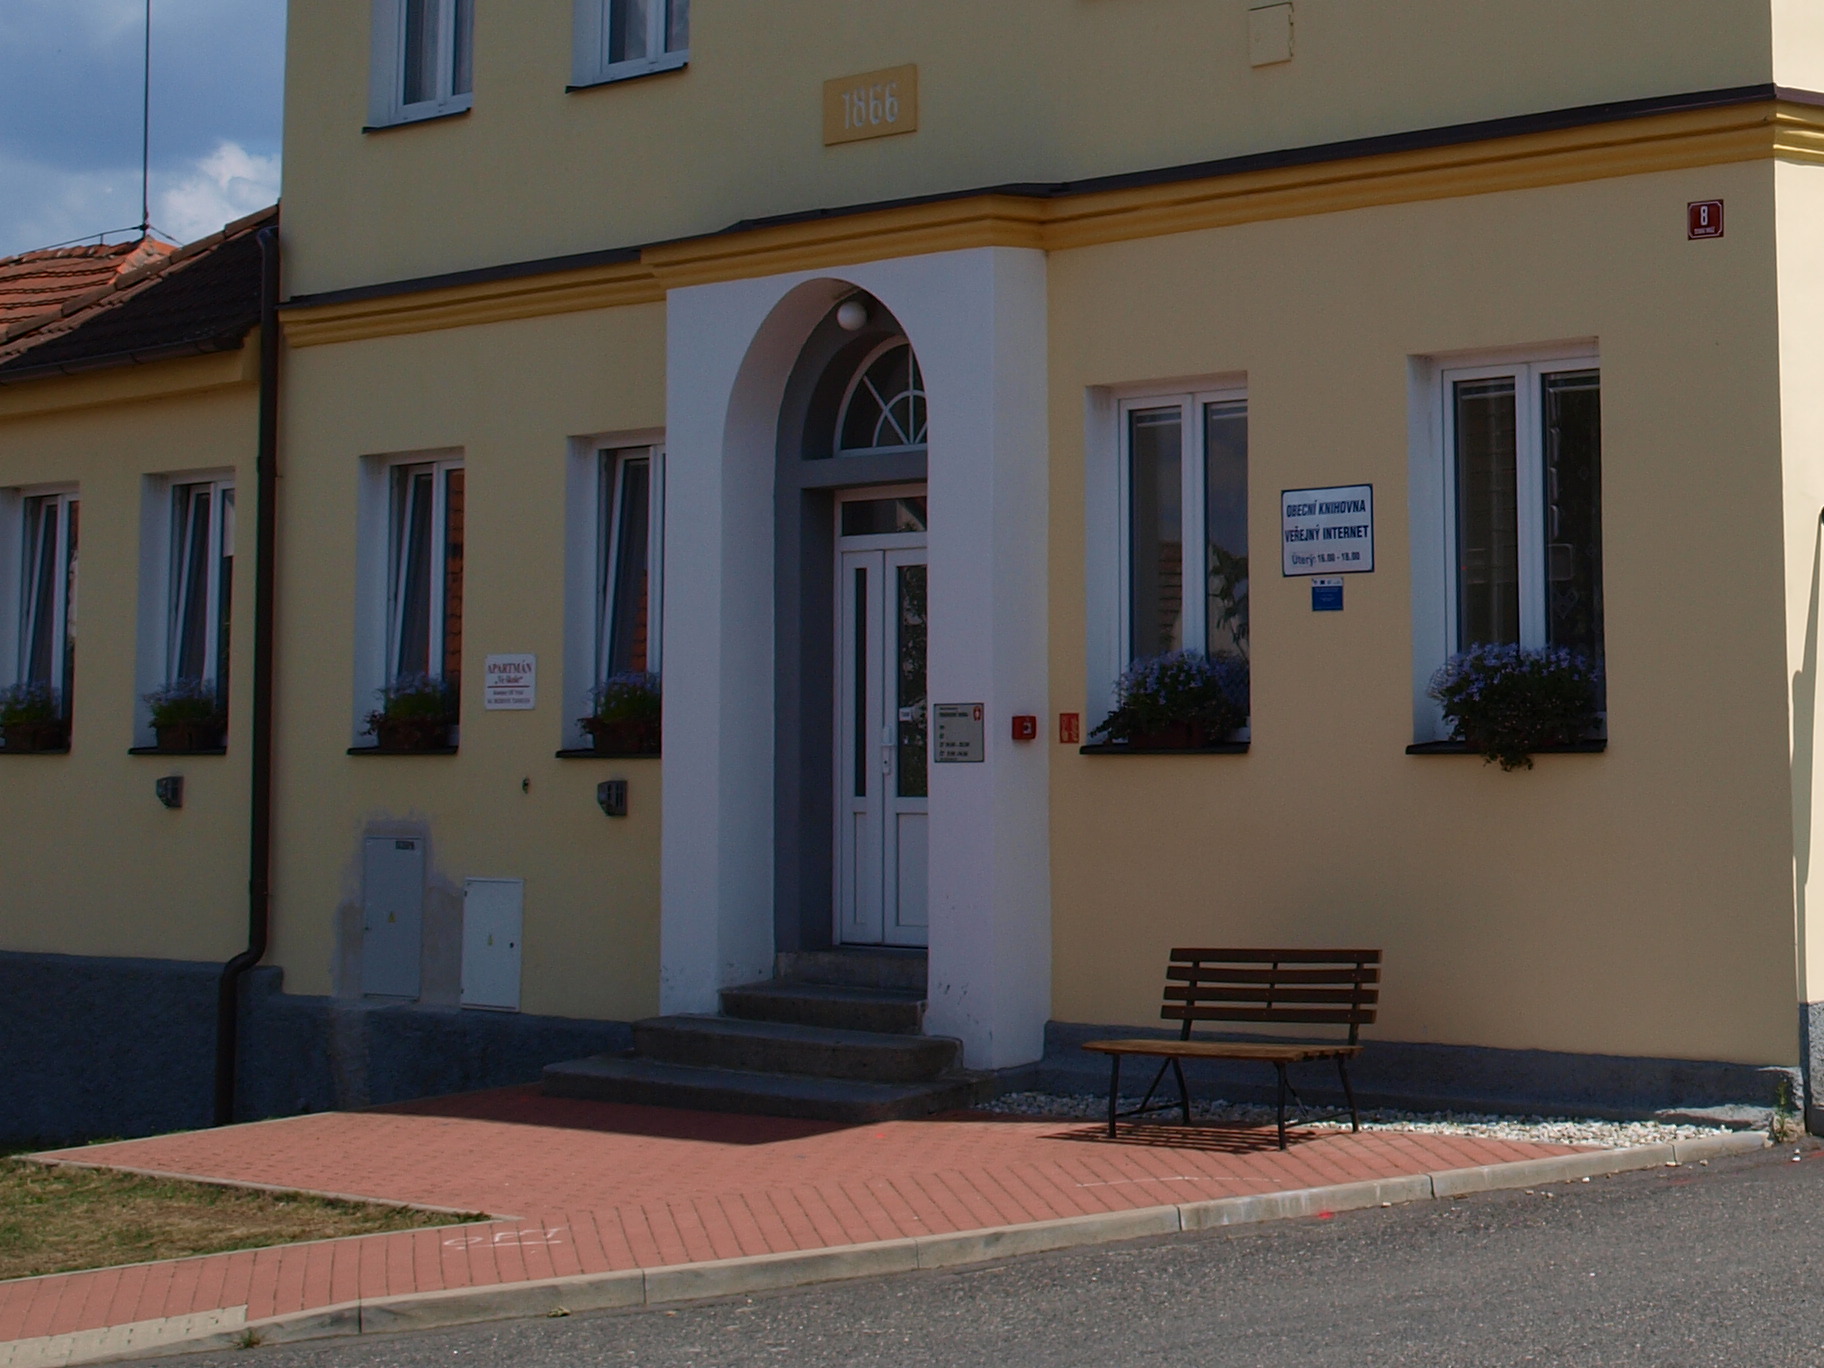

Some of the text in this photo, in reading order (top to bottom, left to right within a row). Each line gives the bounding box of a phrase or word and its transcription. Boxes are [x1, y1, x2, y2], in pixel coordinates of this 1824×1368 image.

[842, 80, 898, 130] 1866
[1700, 205, 1708, 226] 8
[1286, 500, 1366, 517] OBECNÍ KNIHOVNA
[1285, 524, 1369, 542] VEŘEJNÝ INTERNET
[488, 660, 532, 674] APARTMÁN
